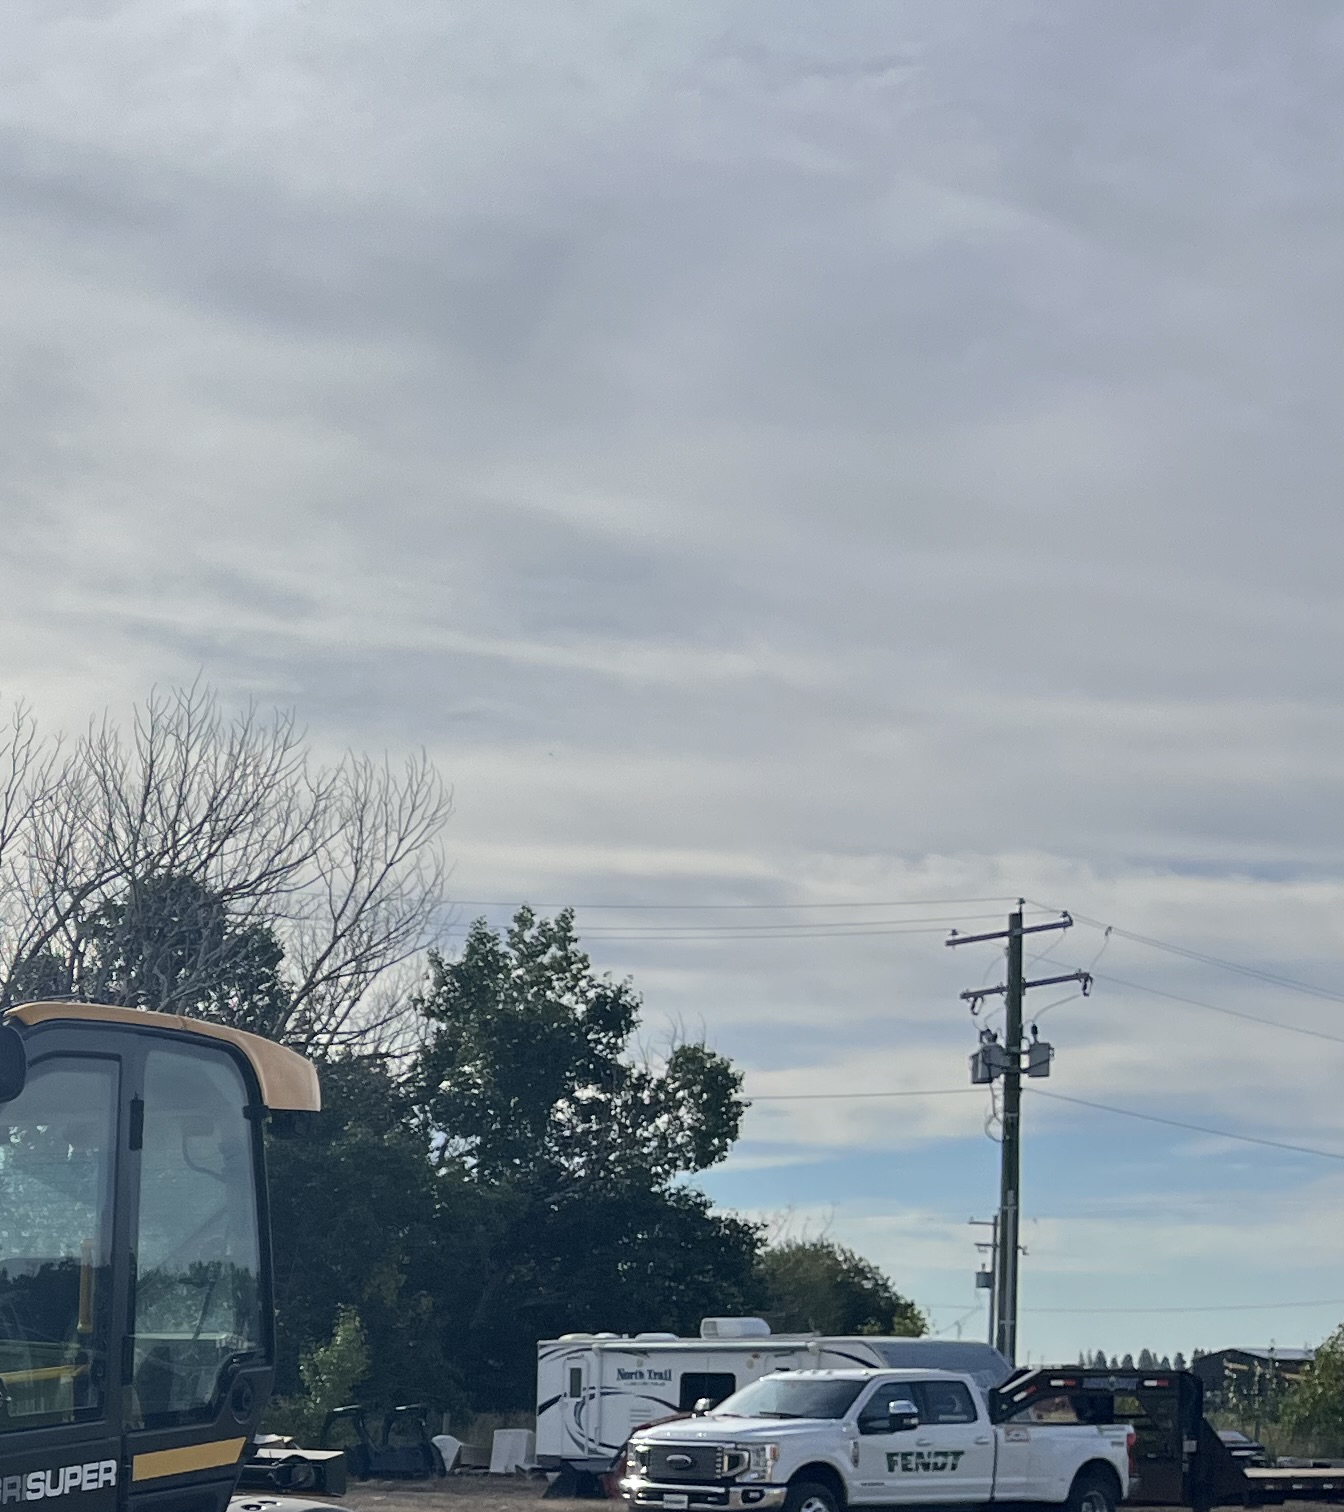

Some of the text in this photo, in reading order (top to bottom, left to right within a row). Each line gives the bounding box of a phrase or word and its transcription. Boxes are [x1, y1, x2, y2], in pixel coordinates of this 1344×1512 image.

[616, 1368, 672, 1381] North Trail
[885, 1451, 965, 1473] FENDT
